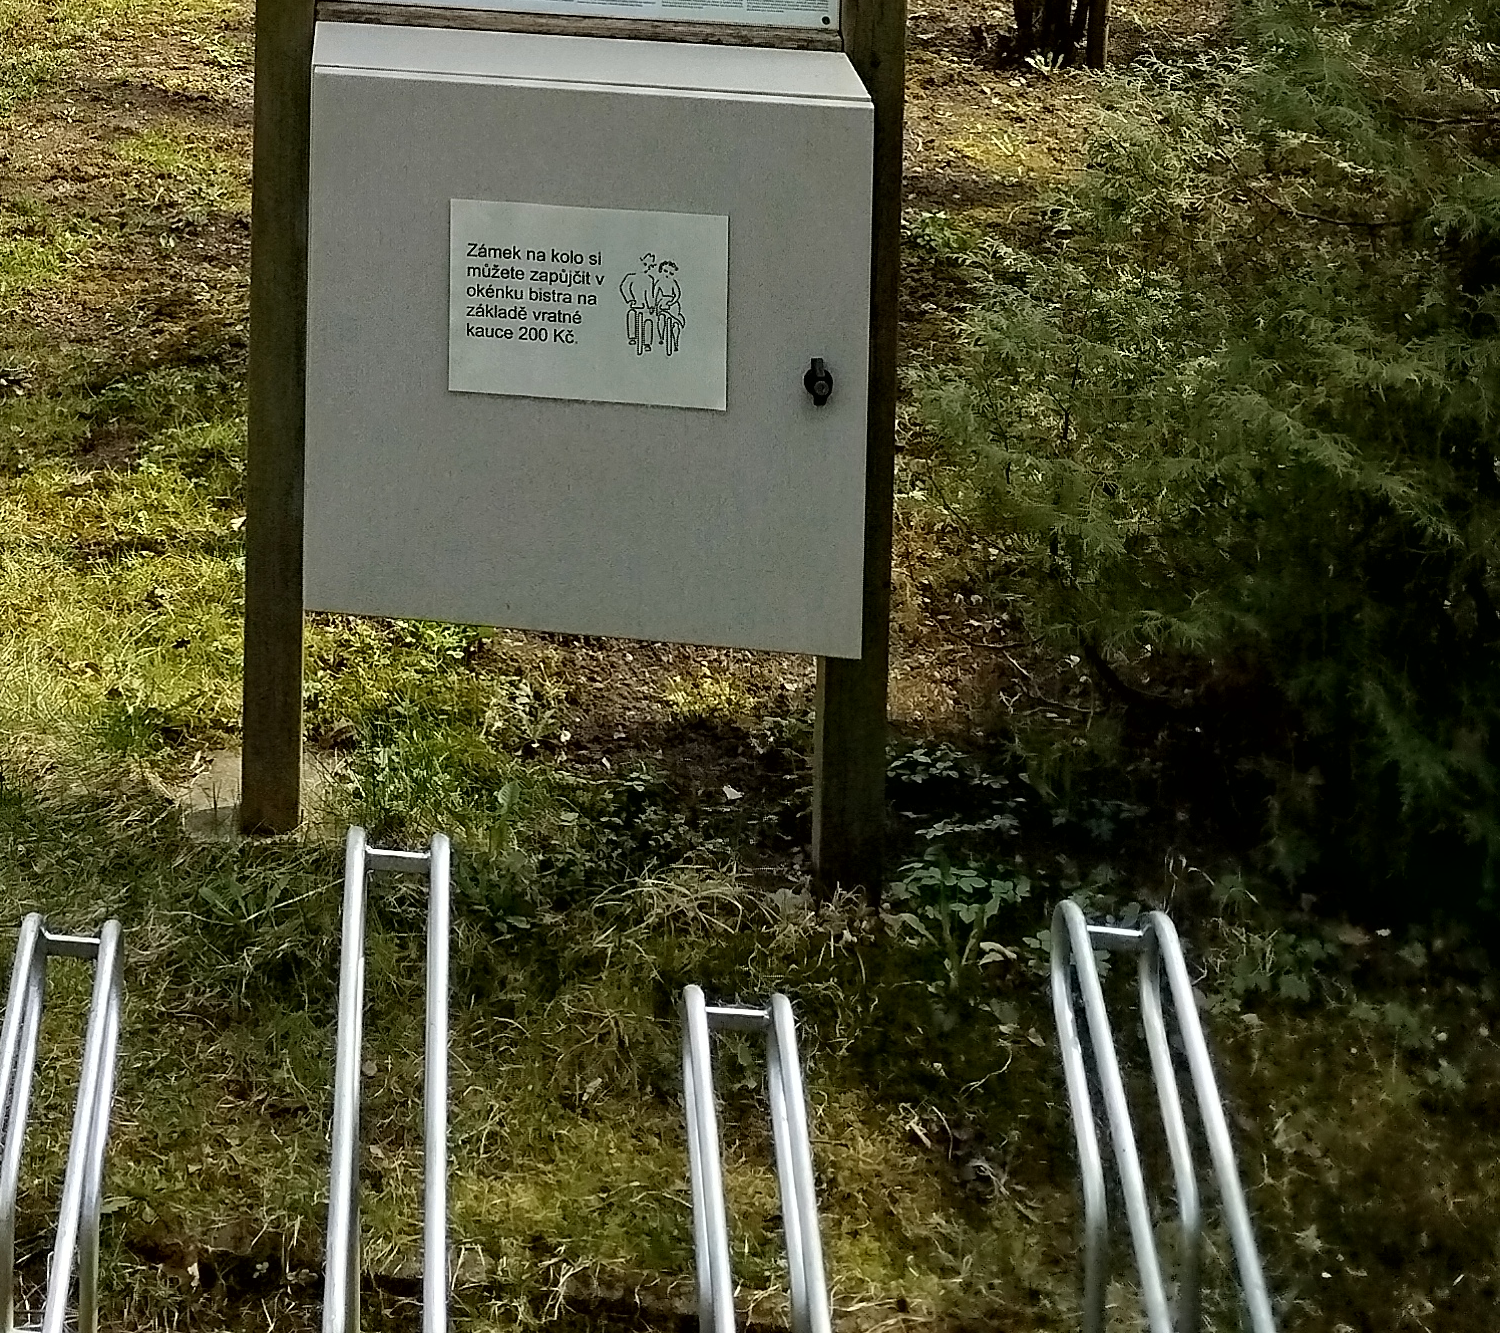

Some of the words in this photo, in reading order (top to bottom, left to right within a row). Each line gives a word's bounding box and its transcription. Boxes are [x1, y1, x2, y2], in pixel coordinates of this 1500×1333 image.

[466, 243, 521, 260] Zámek
[526, 250, 546, 262] na
[551, 248, 583, 265] kolo
[588, 251, 602, 266] si
[466, 262, 525, 281] můžete
[530, 268, 591, 288] zapůjčit
[595, 274, 605, 285] v
[466, 284, 524, 301] okénku
[529, 287, 572, 305] bistra
[577, 293, 597, 306] na
[466, 304, 528, 321] základě
[532, 309, 582, 324] vratné
[466, 323, 514, 340] kauce
[518, 326, 548, 342] 200
[553, 328, 579, 345] Kč.
